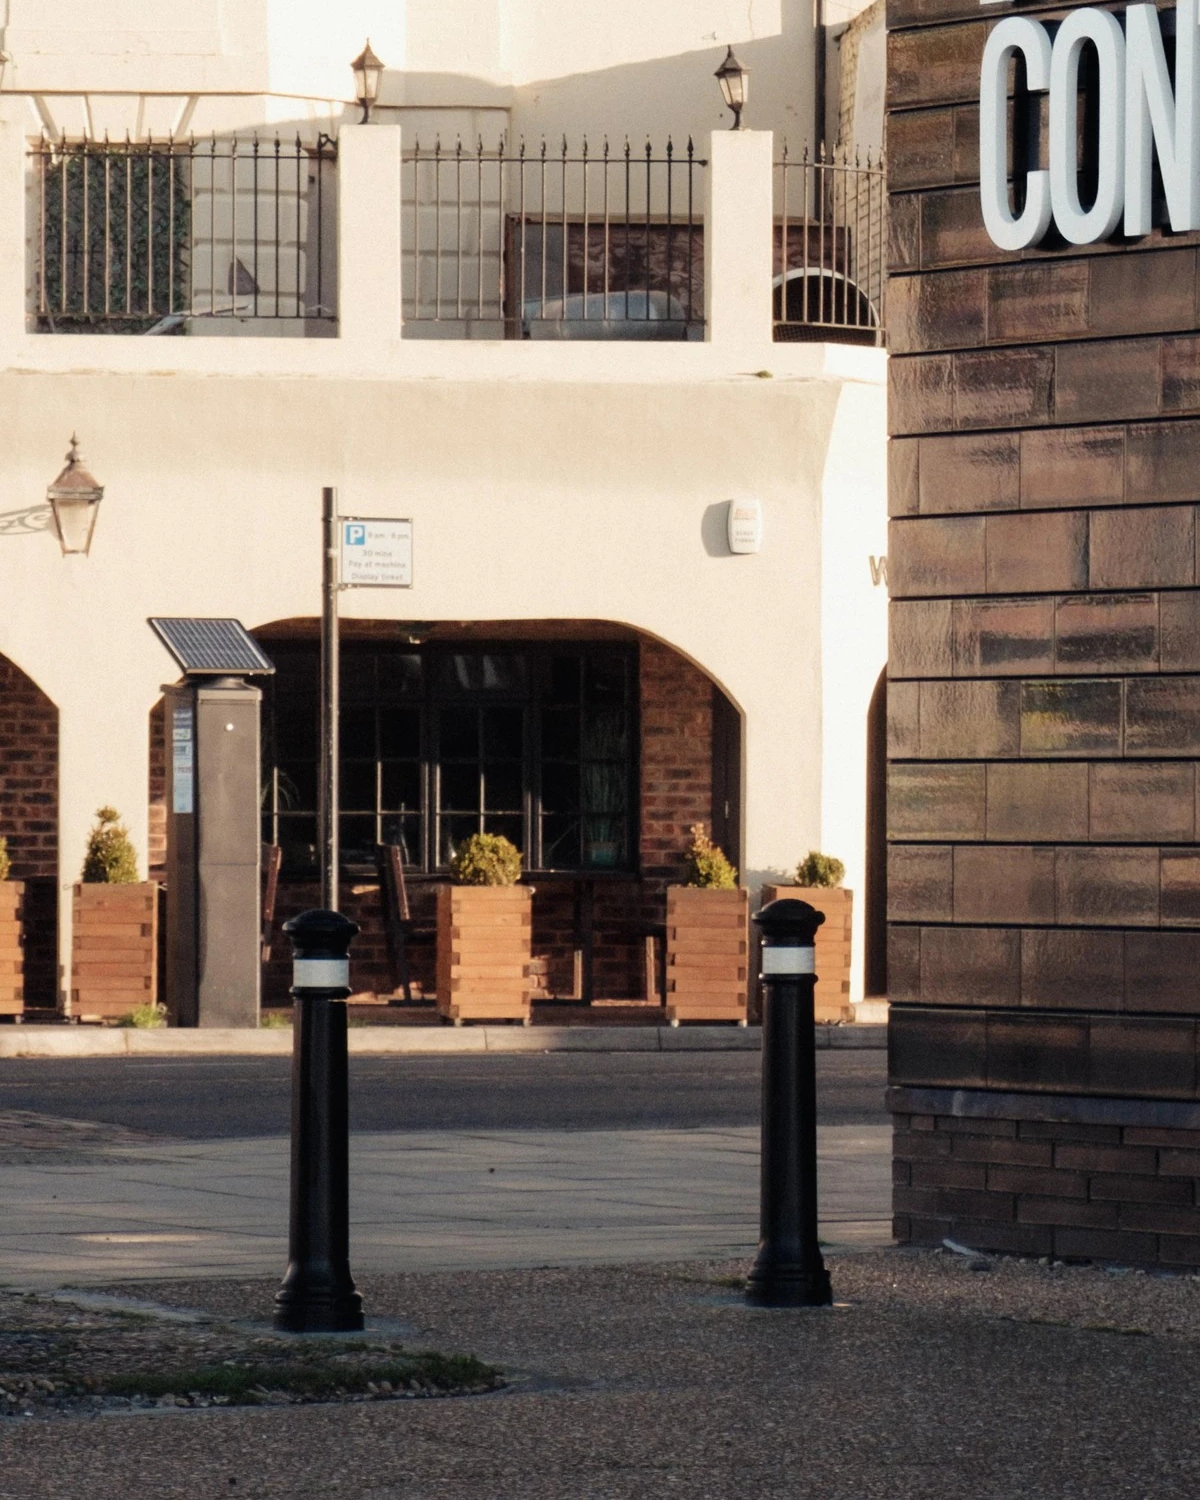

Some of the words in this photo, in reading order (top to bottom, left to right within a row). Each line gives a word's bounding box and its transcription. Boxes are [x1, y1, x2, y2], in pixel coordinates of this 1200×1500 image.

[349, 526, 363, 544] P
[348, 560, 362, 569] Pay
[374, 560, 406, 568] machine
[351, 573, 378, 581] Display
[381, 573, 403, 581] ticket
